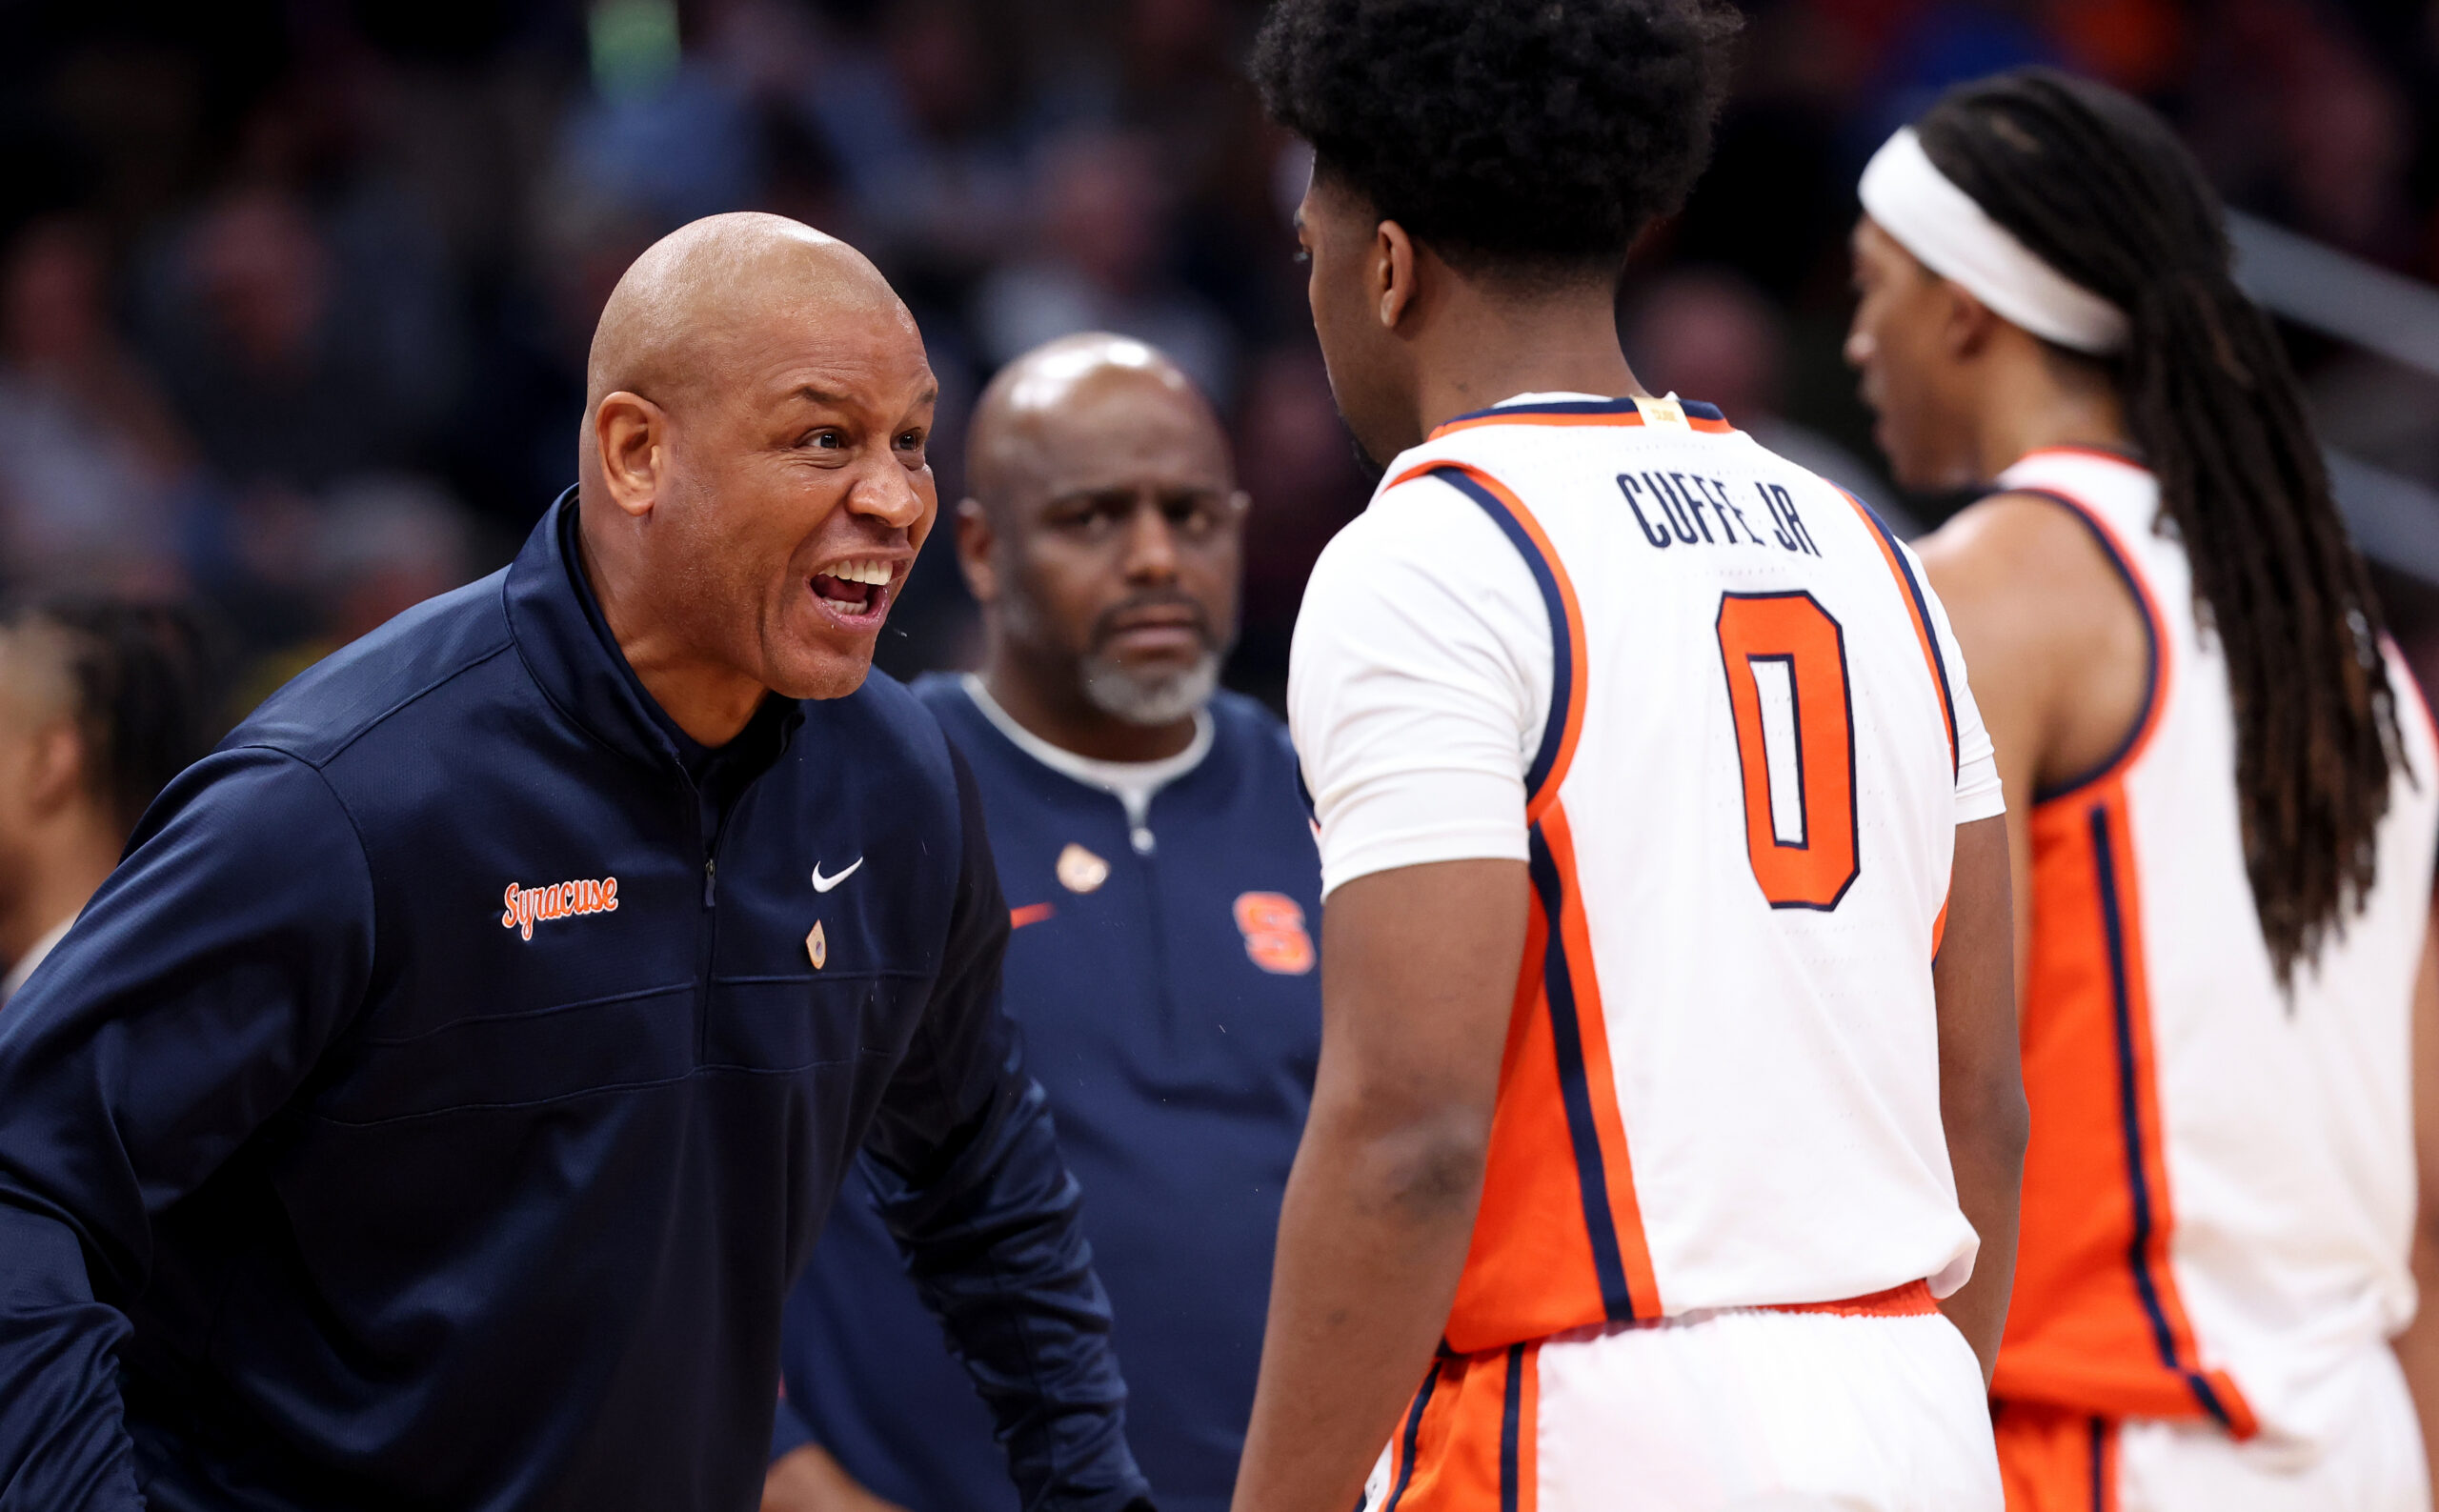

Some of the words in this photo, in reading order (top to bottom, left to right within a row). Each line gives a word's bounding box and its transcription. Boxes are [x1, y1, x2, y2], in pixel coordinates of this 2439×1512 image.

[1616, 472, 1765, 549] CUFFE
[1754, 481, 1823, 558] JR
[1716, 590, 1861, 912] 0
[502, 877, 618, 941] Syracuse
[1232, 891, 1316, 976] S
